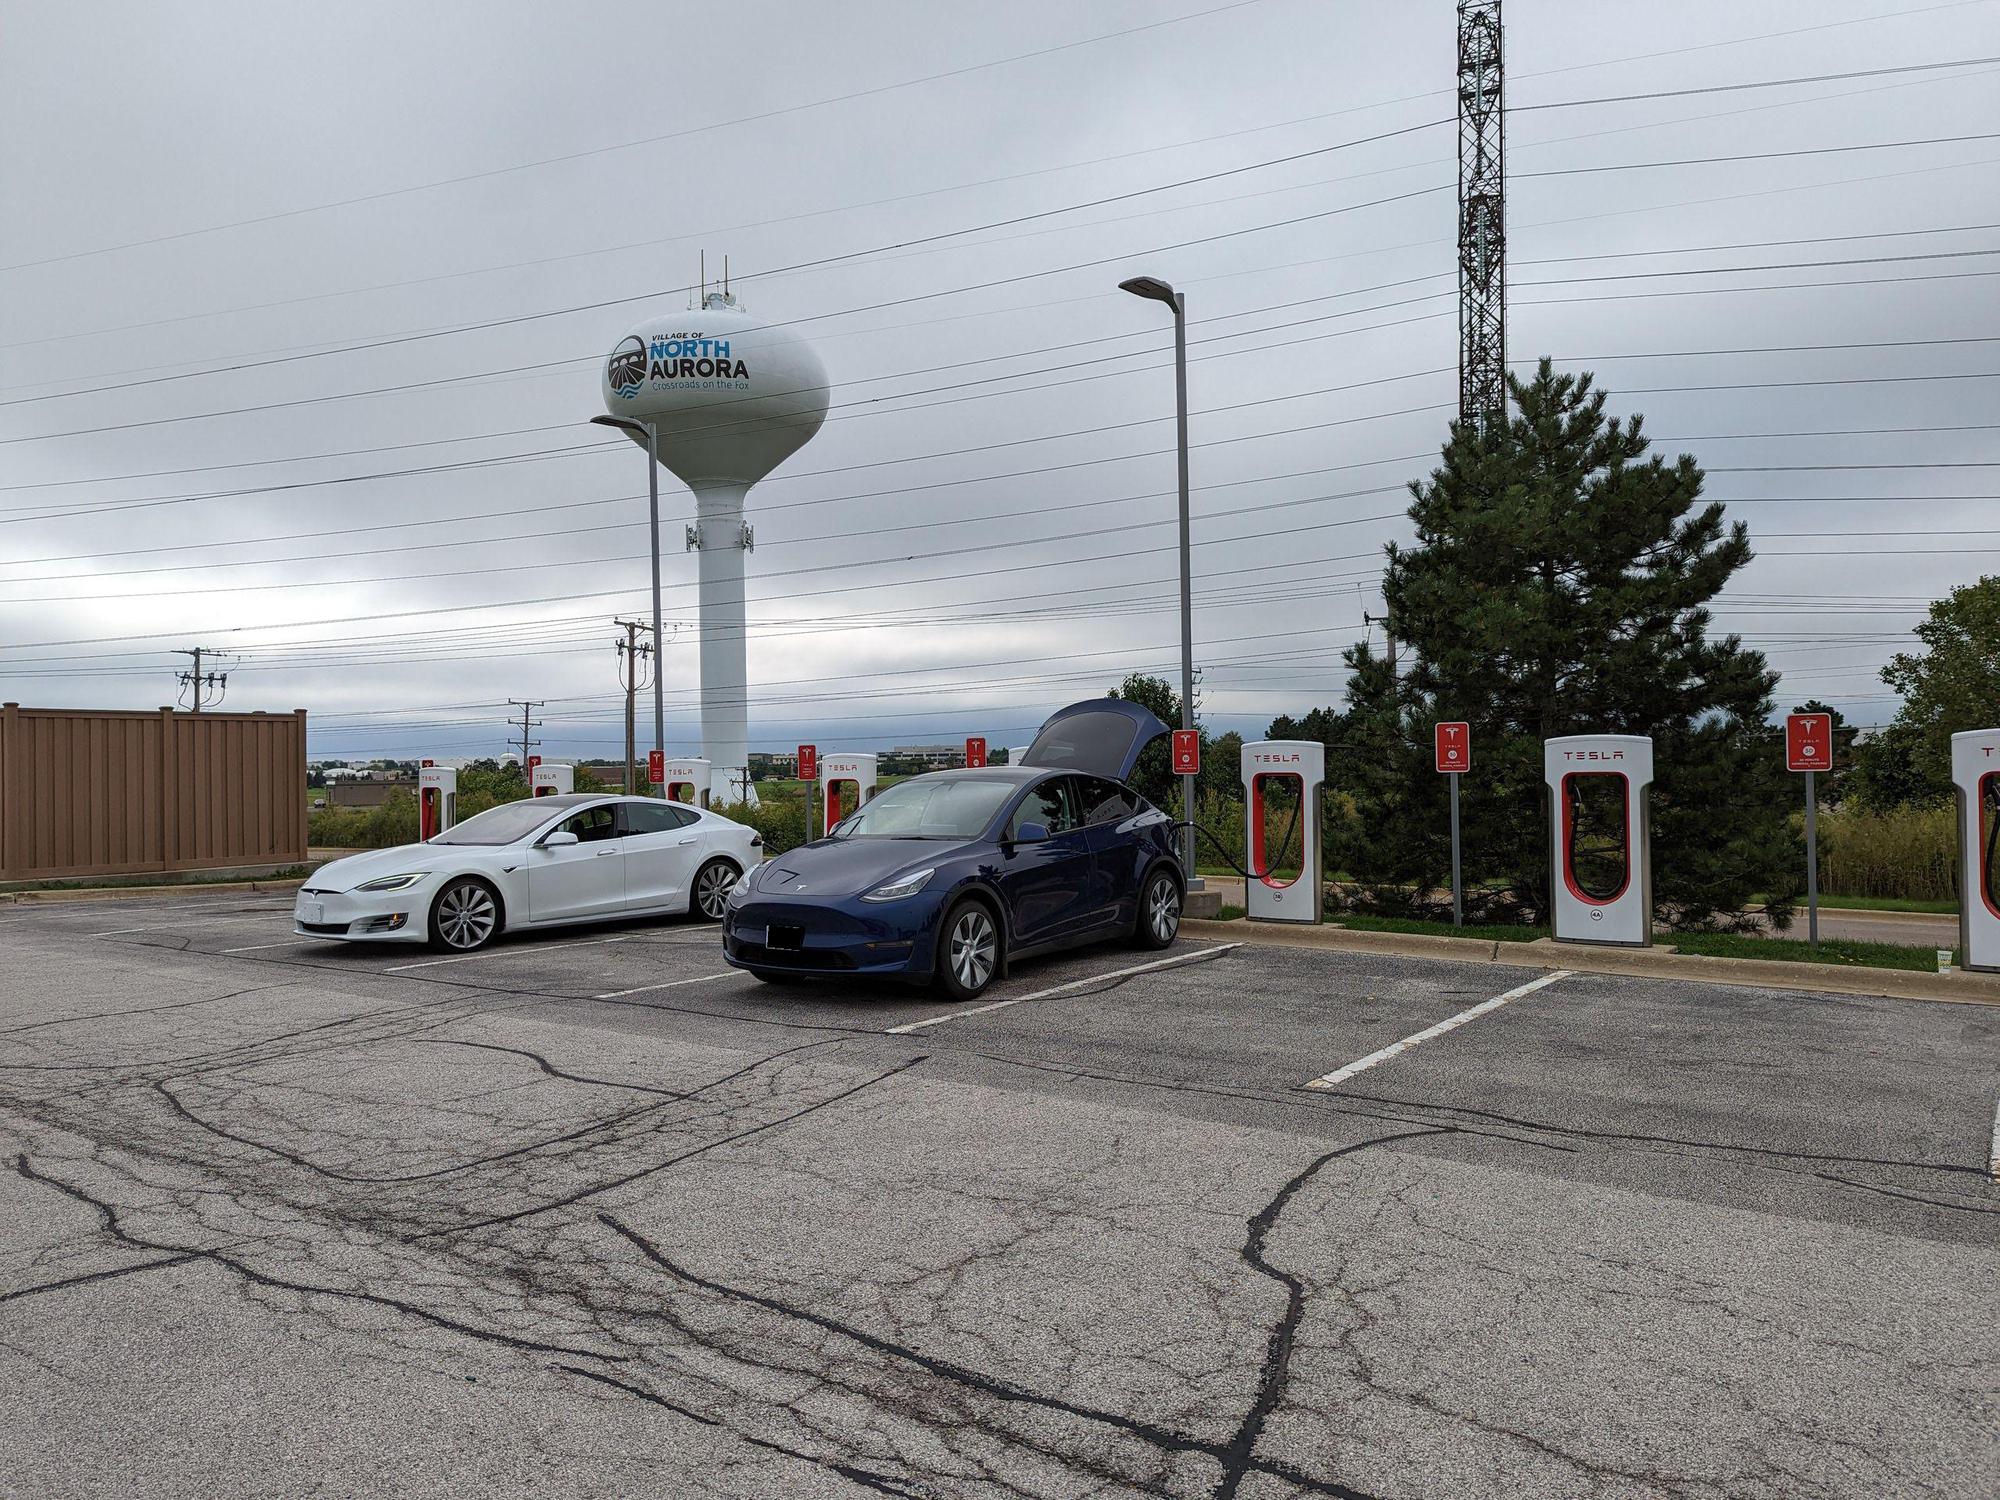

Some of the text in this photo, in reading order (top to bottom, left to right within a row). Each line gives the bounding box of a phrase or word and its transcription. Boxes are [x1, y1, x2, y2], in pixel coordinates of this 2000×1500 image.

[652, 332, 688, 341] VILLAGE
[650, 340, 730, 360] NORTH
[650, 358, 750, 380] AURORA
[652, 380, 749, 391] Crossroads on the Fox
[1254, 754, 1300, 763] TESLA
[1564, 751, 1624, 760] TESLA
